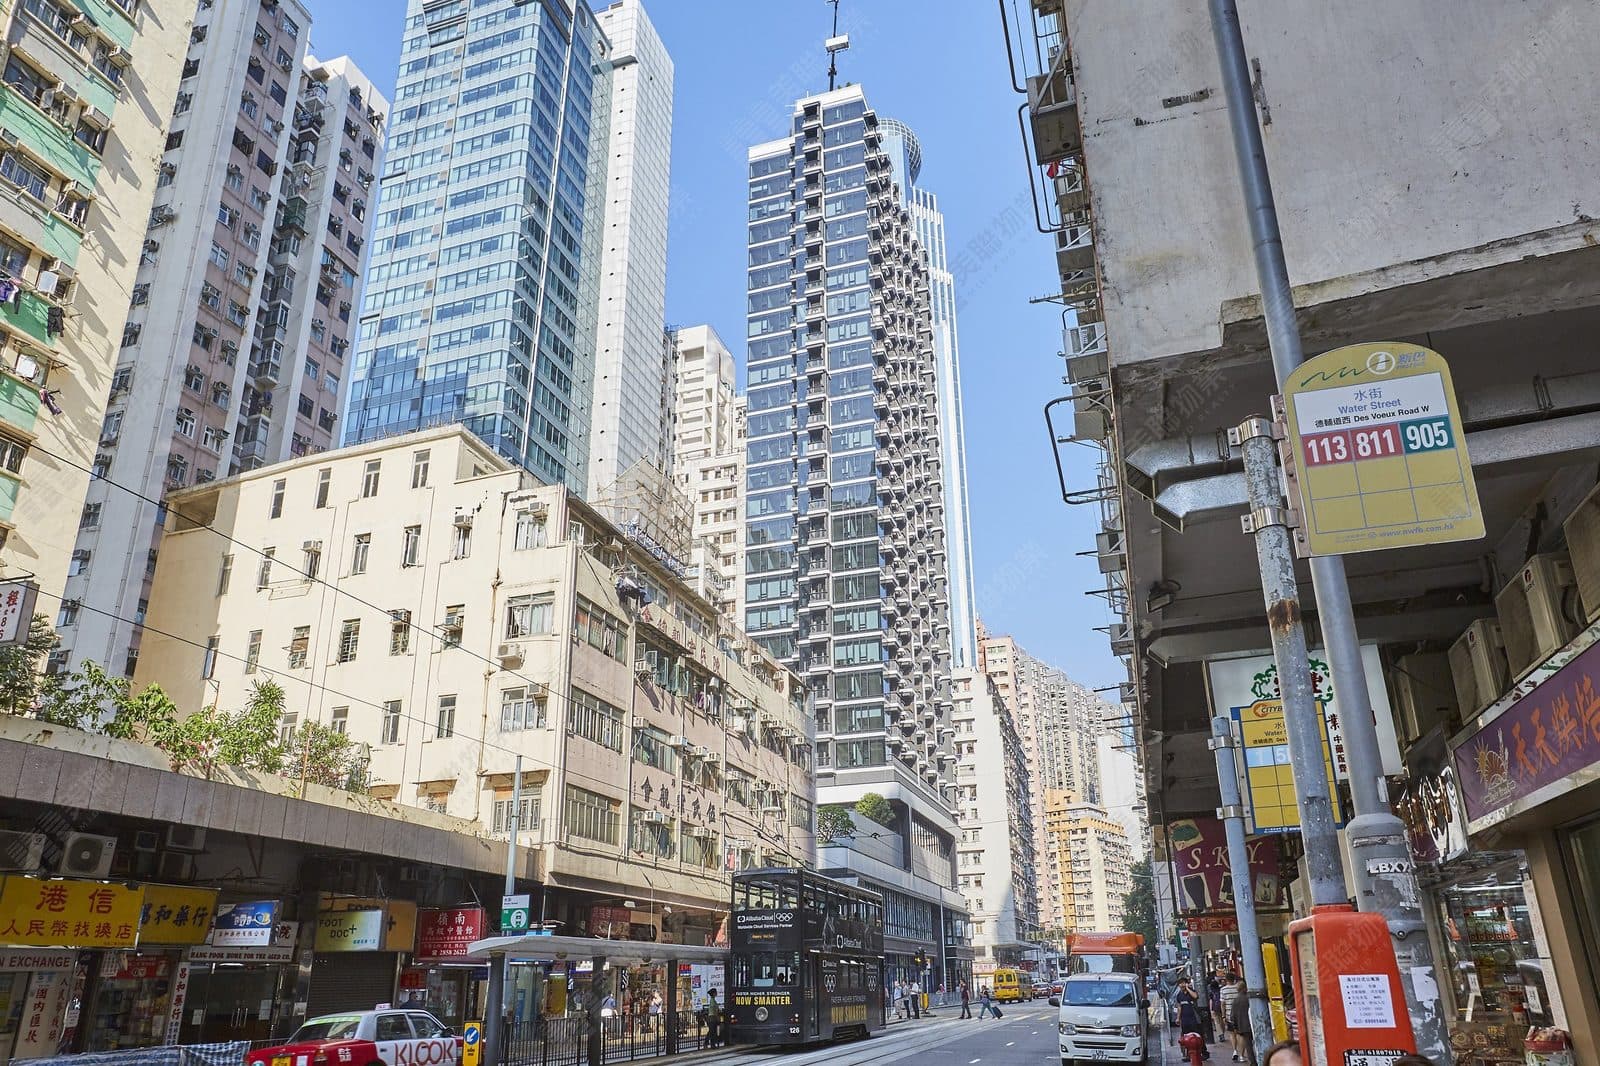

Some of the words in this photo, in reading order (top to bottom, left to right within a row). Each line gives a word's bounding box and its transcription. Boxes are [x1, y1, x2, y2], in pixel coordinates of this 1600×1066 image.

[1353, 387, 1383, 402] 水街
[1337, 404, 1368, 415] Water
[1370, 398, 1401, 410] Street
[1354, 413, 1369, 423] Des
[1371, 410, 1396, 420] Voeux
[1398, 406, 1420, 417] Road
[1421, 405, 1430, 413] W
[1307, 435, 1348, 463] 113
[1355, 428, 1395, 457] 811
[1406, 421, 1449, 450] 905
[36, 885, 116, 914] 港信
[1, 919, 133, 939] 人民幣找換店
[9, 956, 71, 968] EXCHANGE
[735, 996, 750, 1006] NOW
[394, 1039, 454, 1066] KLOOK
